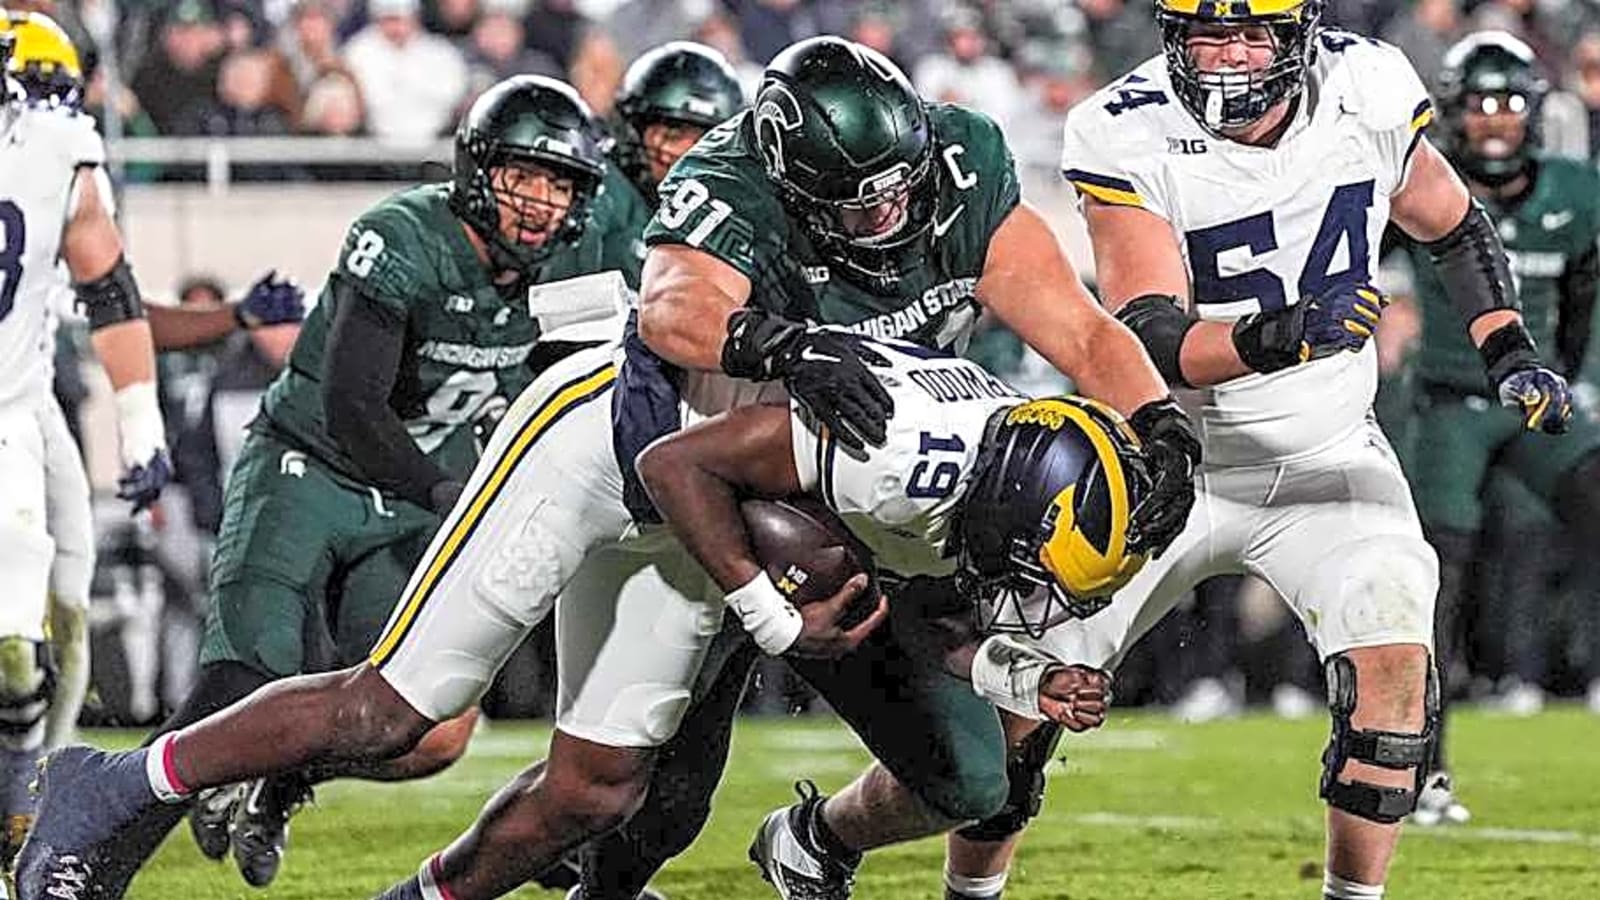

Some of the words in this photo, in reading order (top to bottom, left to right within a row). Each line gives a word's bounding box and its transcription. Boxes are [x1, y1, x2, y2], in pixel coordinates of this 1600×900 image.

[943, 144, 978, 189] C
[659, 178, 733, 248] 91
[1184, 178, 1376, 313] 54
[346, 229, 385, 278] 8
[905, 430, 967, 499] 19
